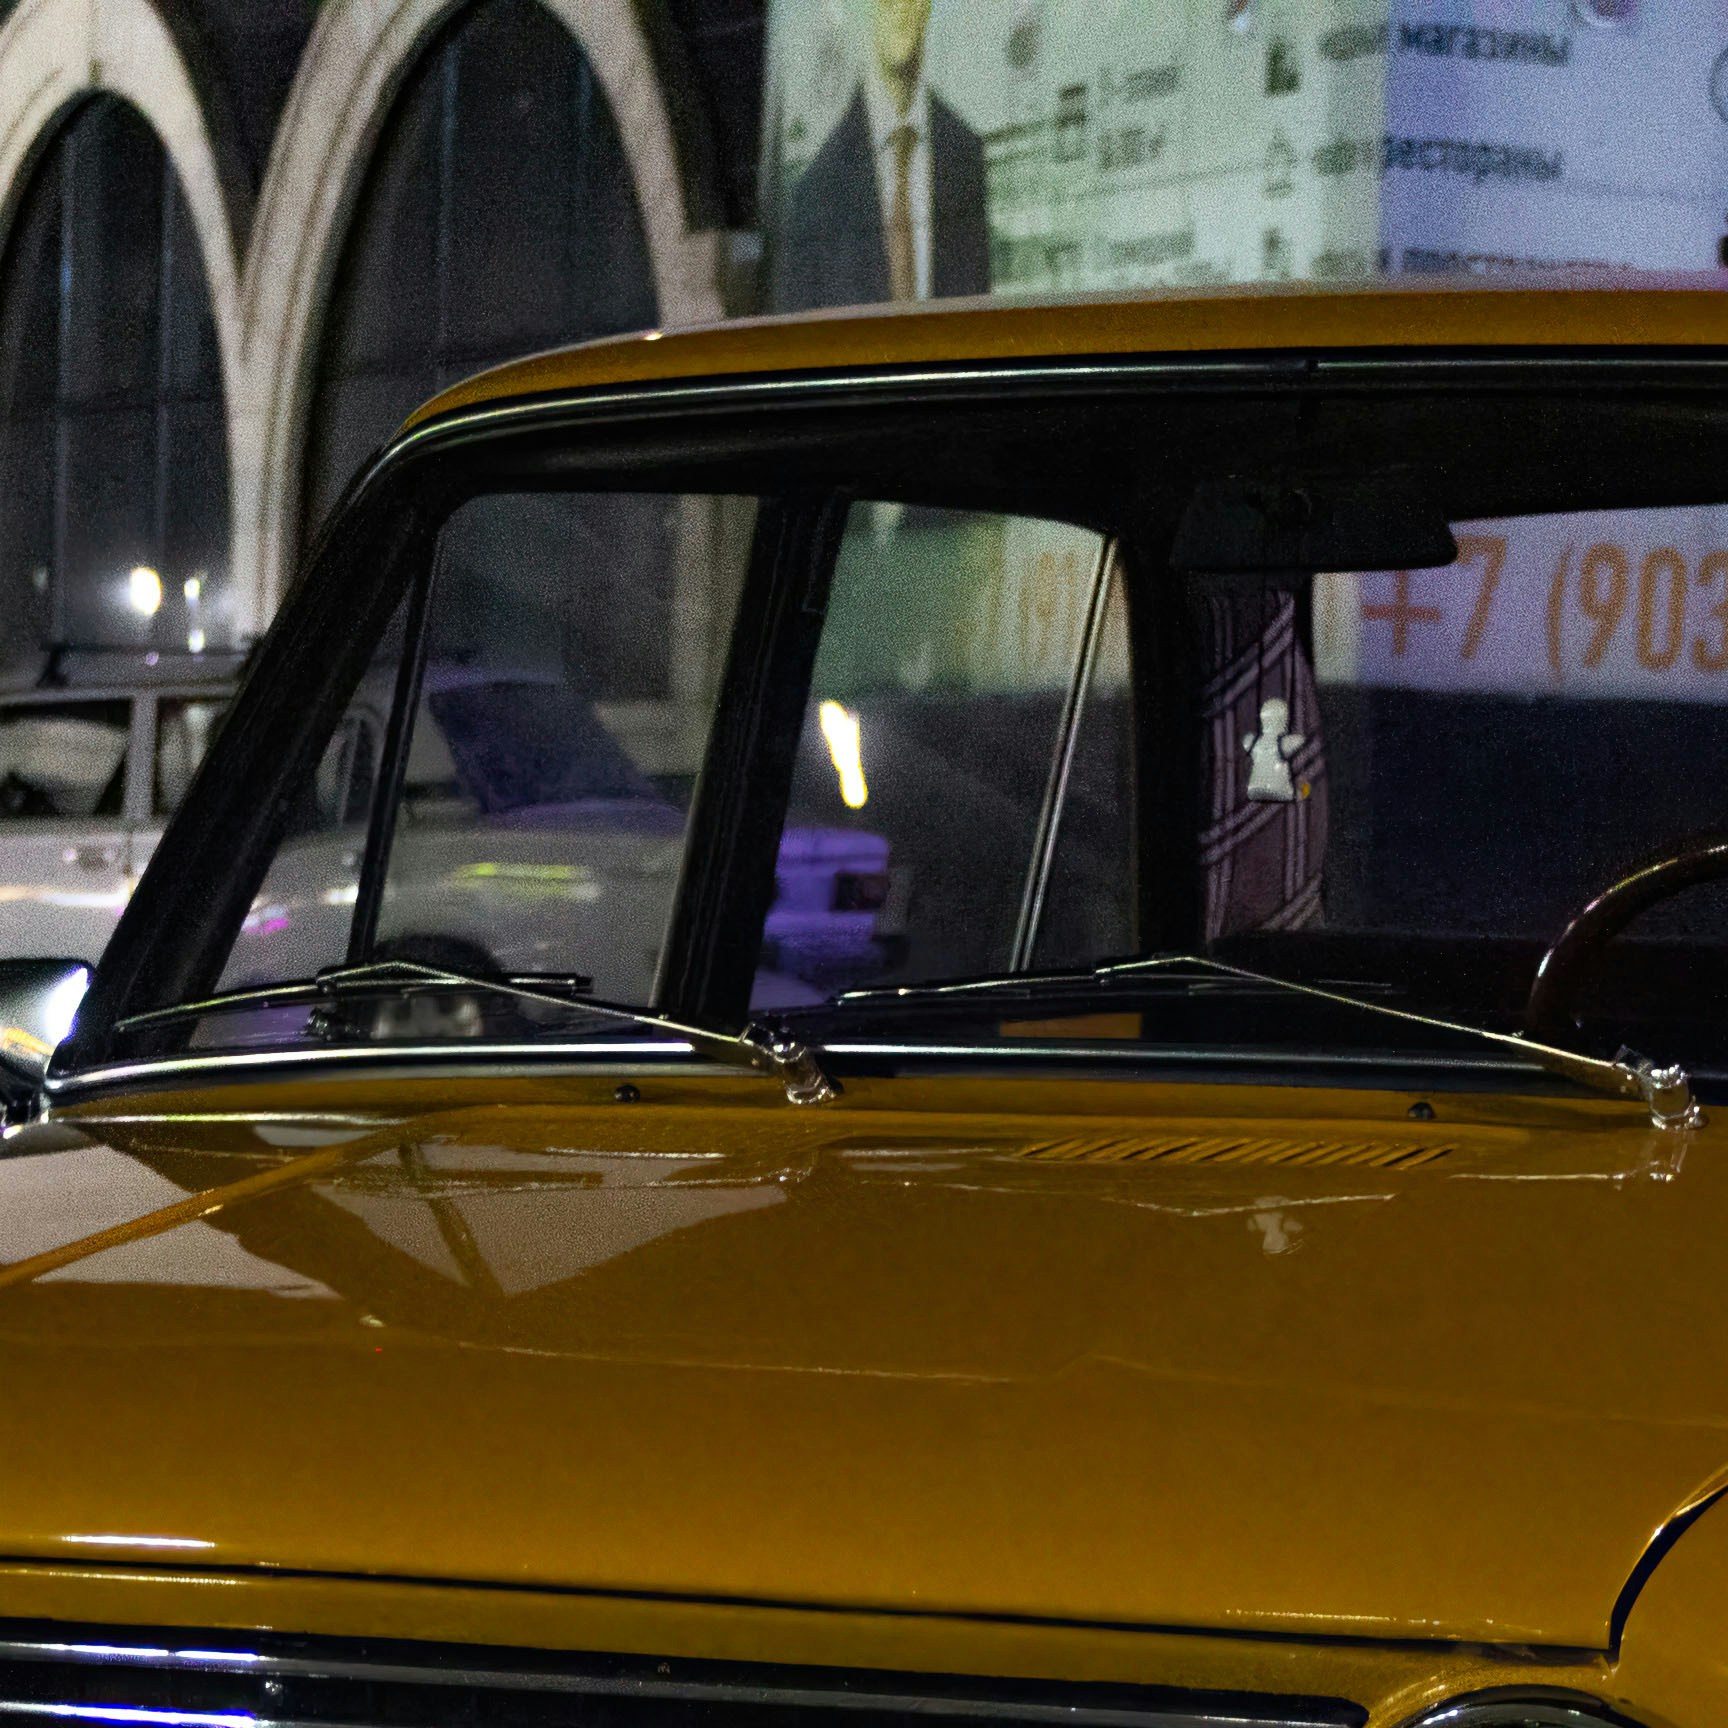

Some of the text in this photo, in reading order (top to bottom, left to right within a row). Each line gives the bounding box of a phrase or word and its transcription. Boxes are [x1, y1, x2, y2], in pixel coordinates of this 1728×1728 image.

[1397, 23, 1570, 66] магазины
[1381, 135, 1564, 184] рестораны
[1360, 536, 1507, 661] +7
